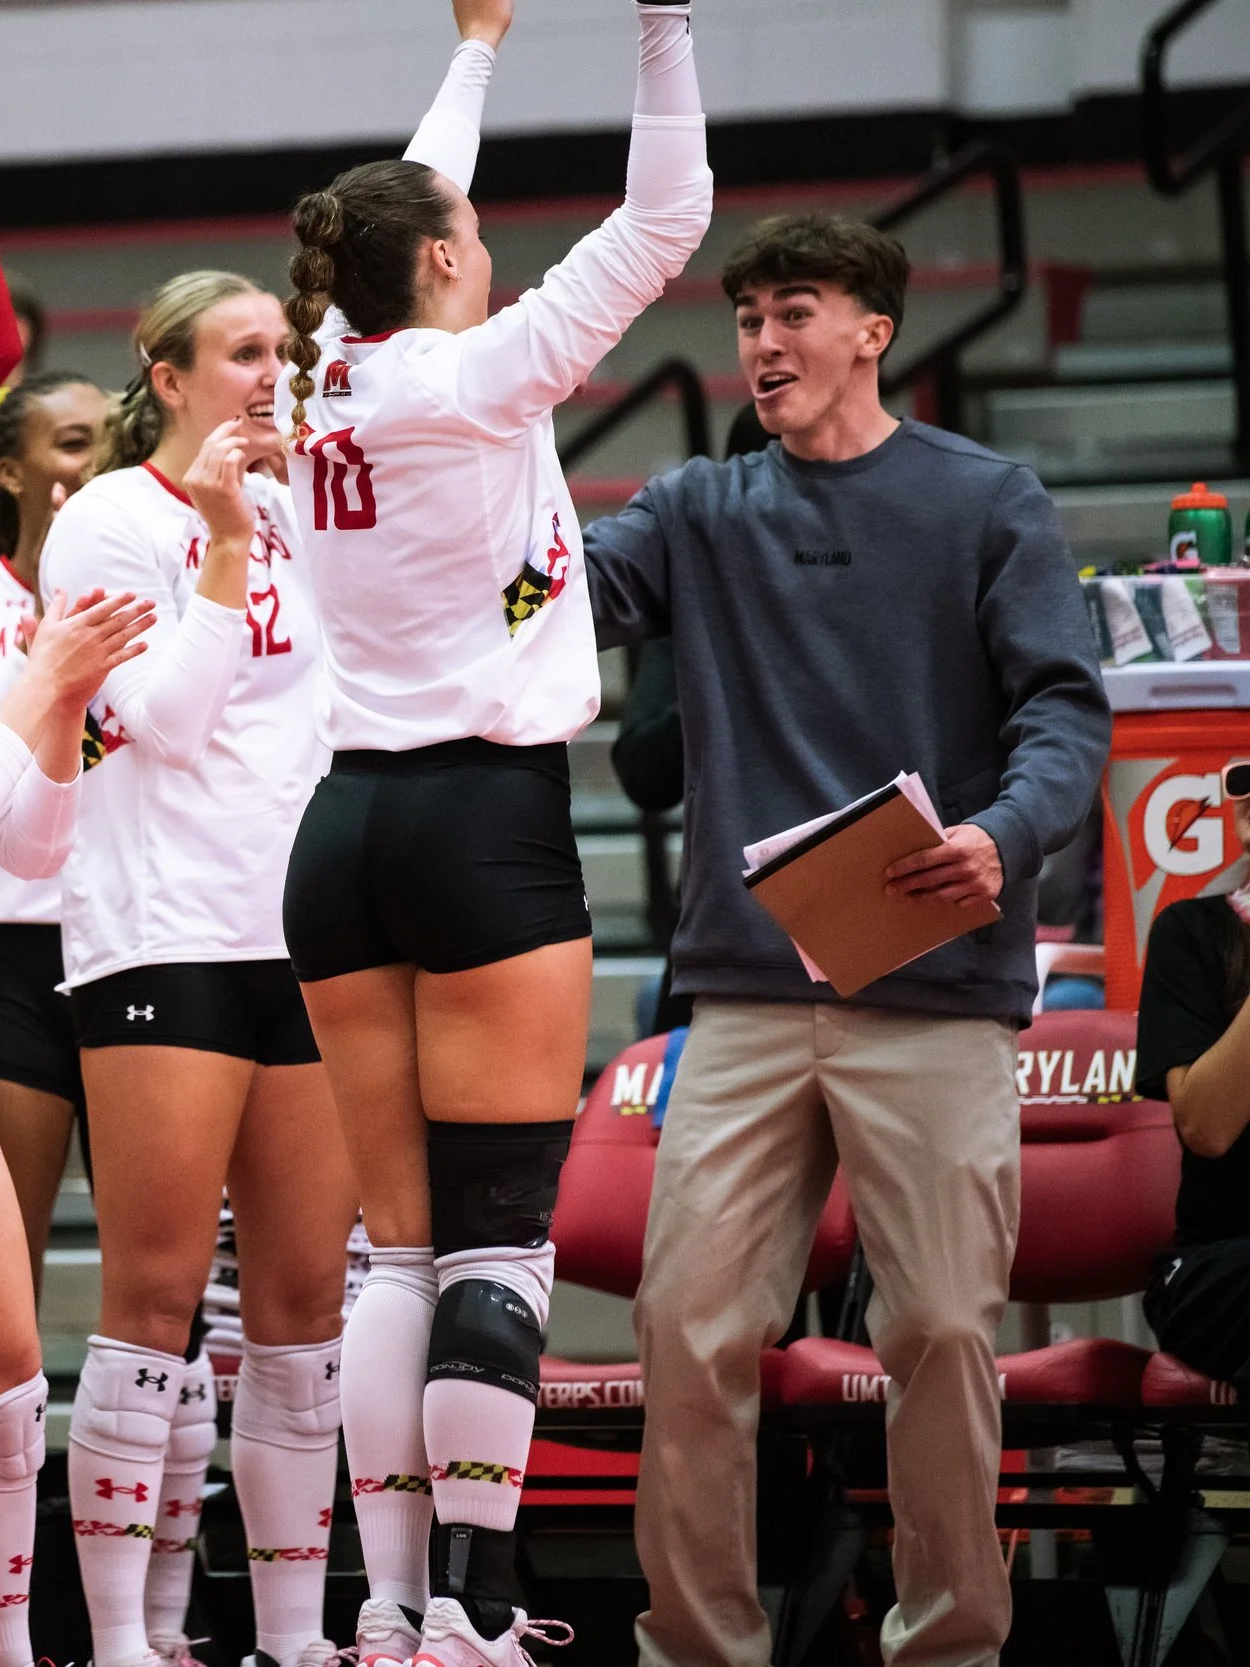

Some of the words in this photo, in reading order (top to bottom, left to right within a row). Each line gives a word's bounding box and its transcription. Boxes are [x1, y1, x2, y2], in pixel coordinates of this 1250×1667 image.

[295, 421, 377, 531] 10
[246, 583, 293, 658] 12
[1143, 772, 1225, 876] G
[1015, 1050, 1138, 1095] RYLAN
